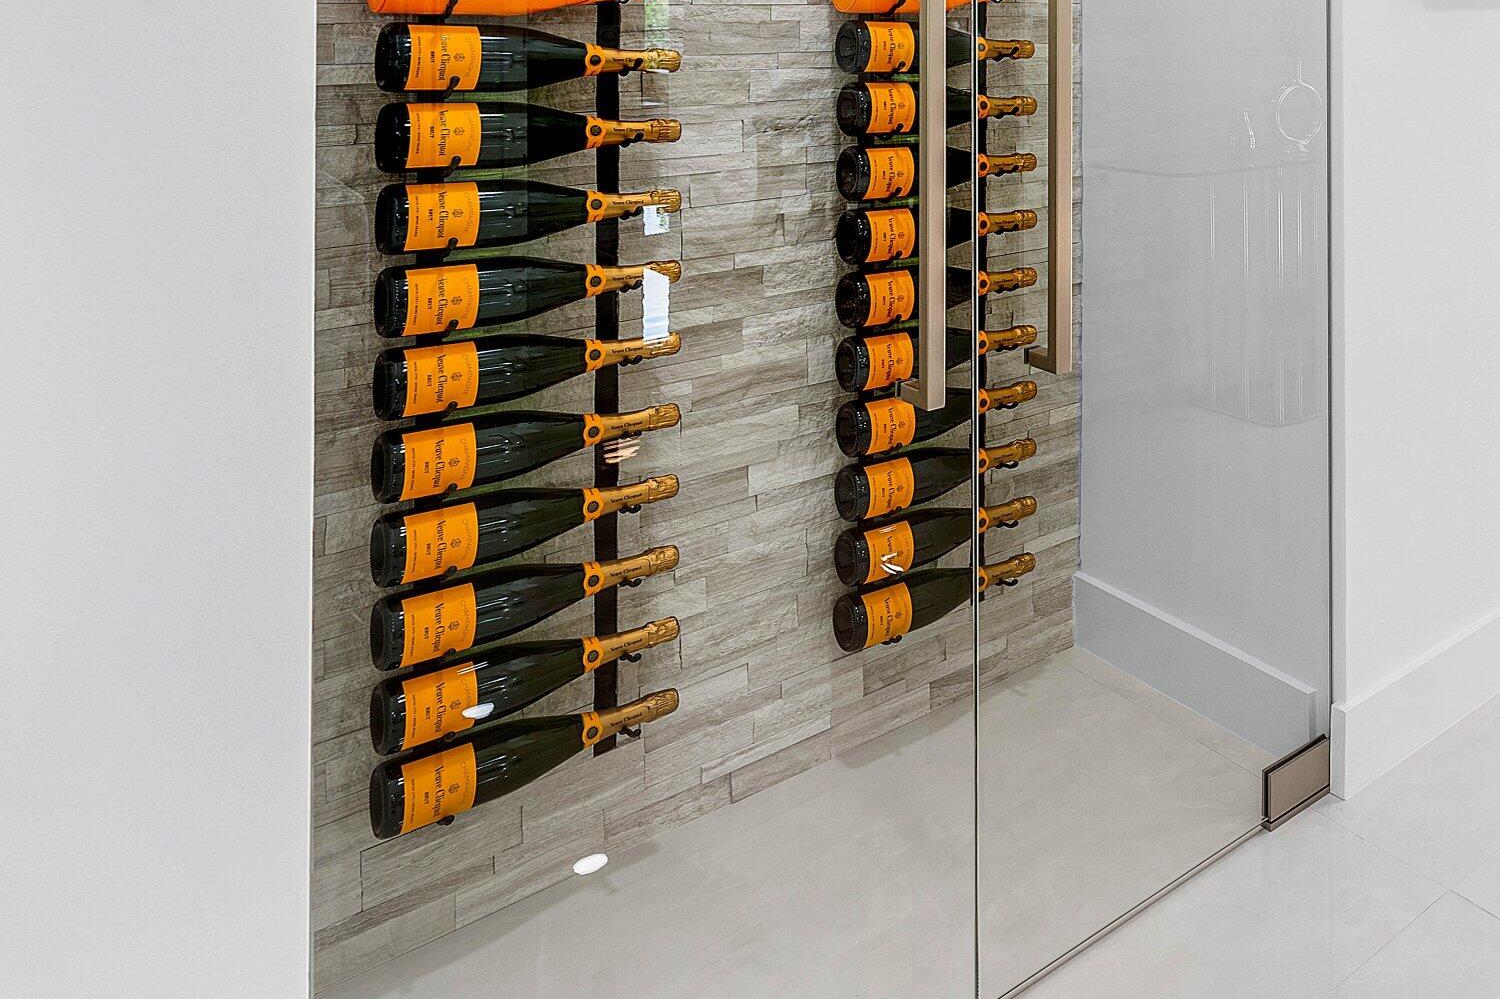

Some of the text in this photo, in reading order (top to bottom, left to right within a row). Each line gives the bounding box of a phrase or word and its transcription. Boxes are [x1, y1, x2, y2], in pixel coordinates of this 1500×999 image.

[438, 34, 450, 81] Veuve Clicquot
[438, 110, 450, 156] Veuve Clicquot
[436, 191, 448, 238] Veuve Clicquot
[435, 279, 448, 326] Veuve Clicquot
[435, 354, 447, 404] Veuve Clicquot
[433, 439, 446, 489] Veuve Clicquot
[434, 520, 447, 570] Veuve Clicquot
[432, 603, 445, 654] Veuve Clicquot
[434, 682, 446, 734] Veuve Clicquot
[433, 765, 446, 817] Veuve Clicquot
